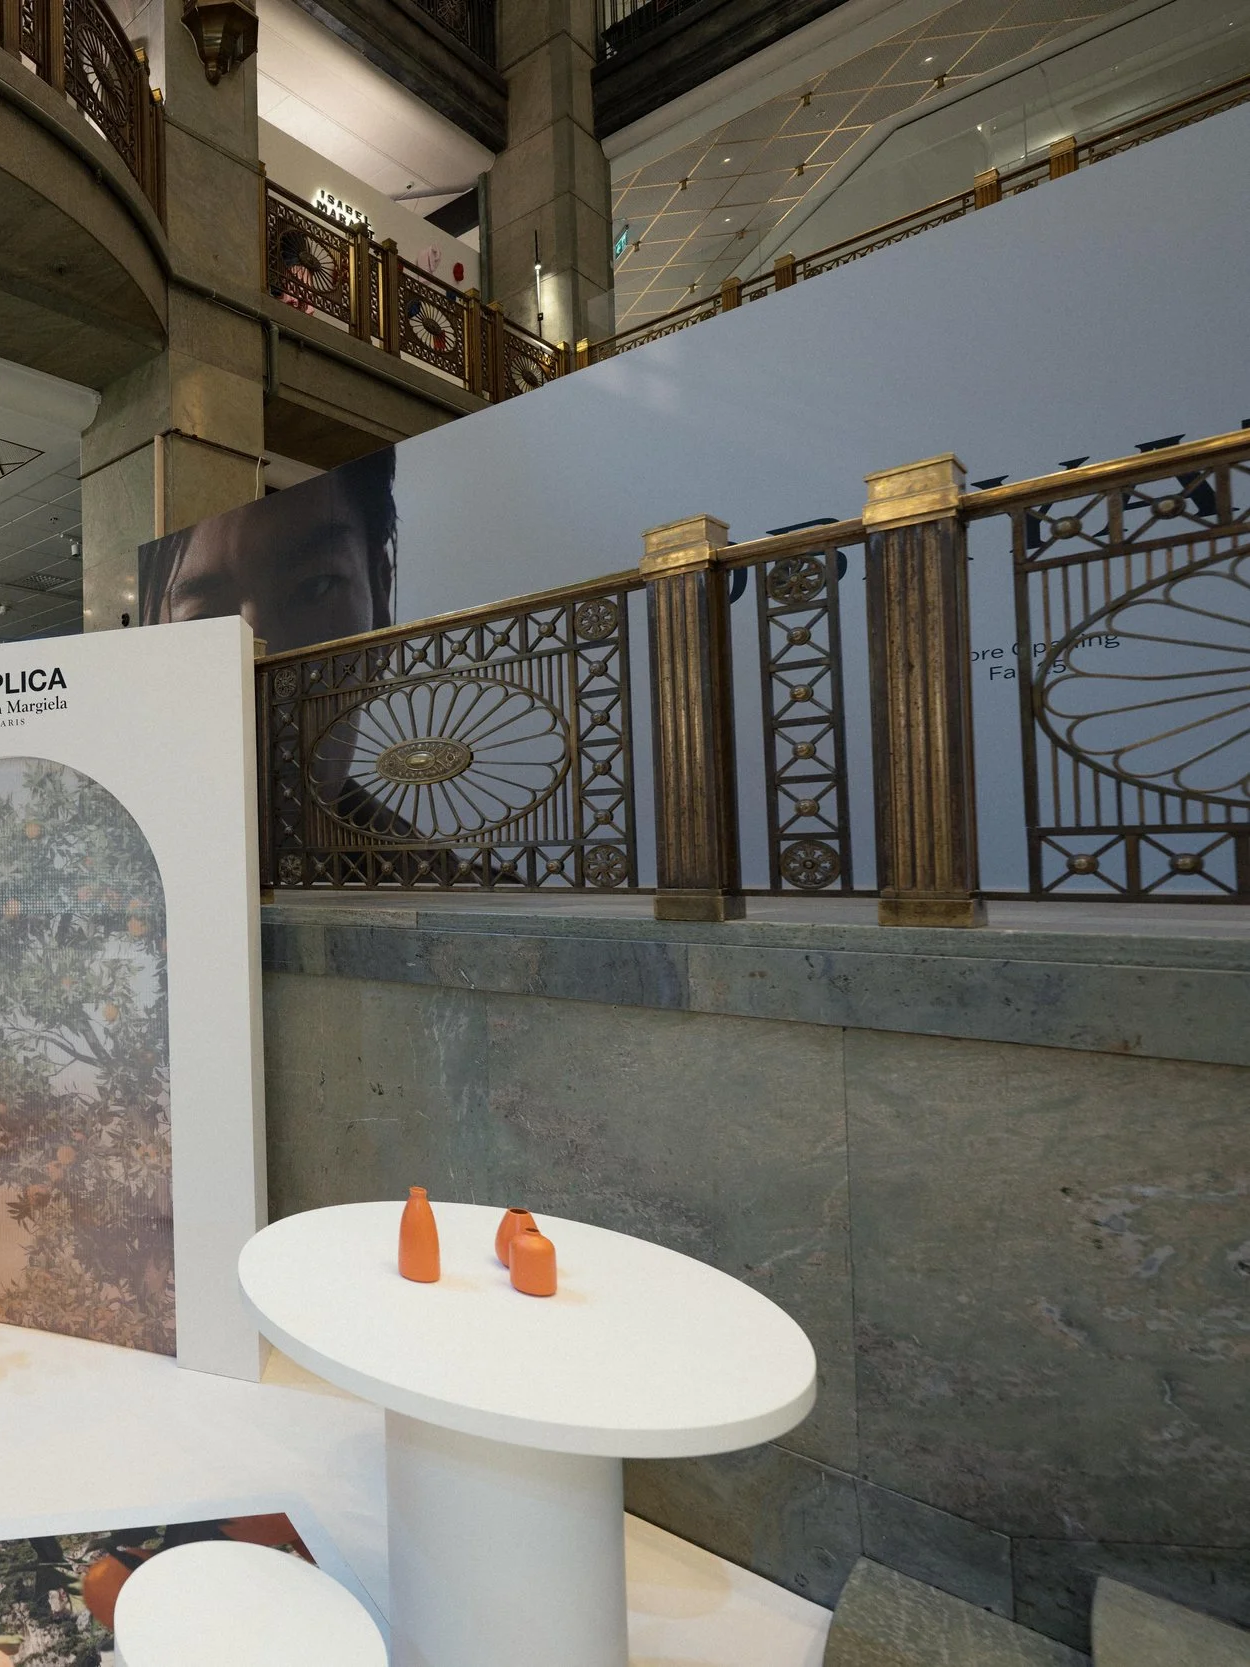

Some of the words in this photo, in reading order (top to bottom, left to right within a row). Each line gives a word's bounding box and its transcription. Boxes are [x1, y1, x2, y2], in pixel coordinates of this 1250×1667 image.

[316, 200, 375, 239] MARAT
[320, 190, 371, 227] ISABEL
[970, 648, 1004, 662] ore
[6, 696, 68, 714] Margiela
